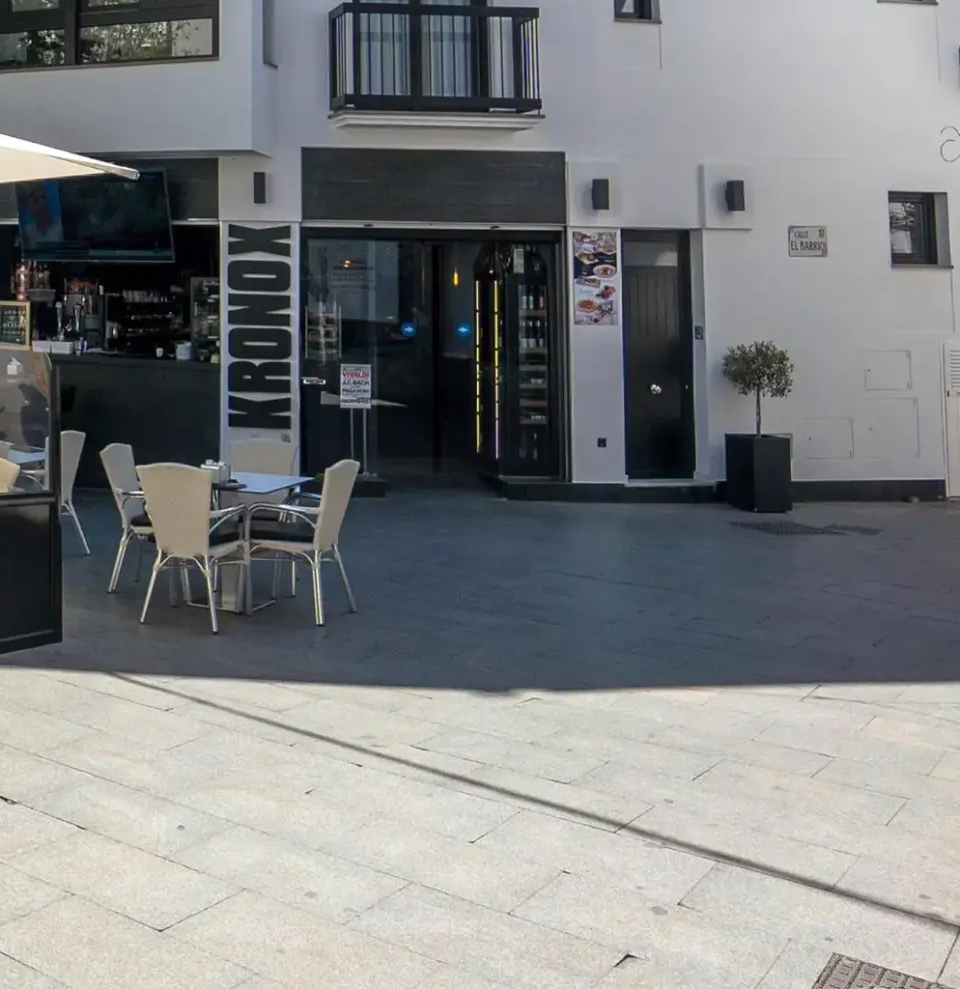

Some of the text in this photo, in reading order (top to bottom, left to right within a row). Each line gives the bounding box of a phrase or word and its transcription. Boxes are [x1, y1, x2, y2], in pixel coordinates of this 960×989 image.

[790, 240, 826, 252] EL BARRIO
[227, 223, 292, 430] KRONOX
[342, 371, 369, 379] VIVALDI
